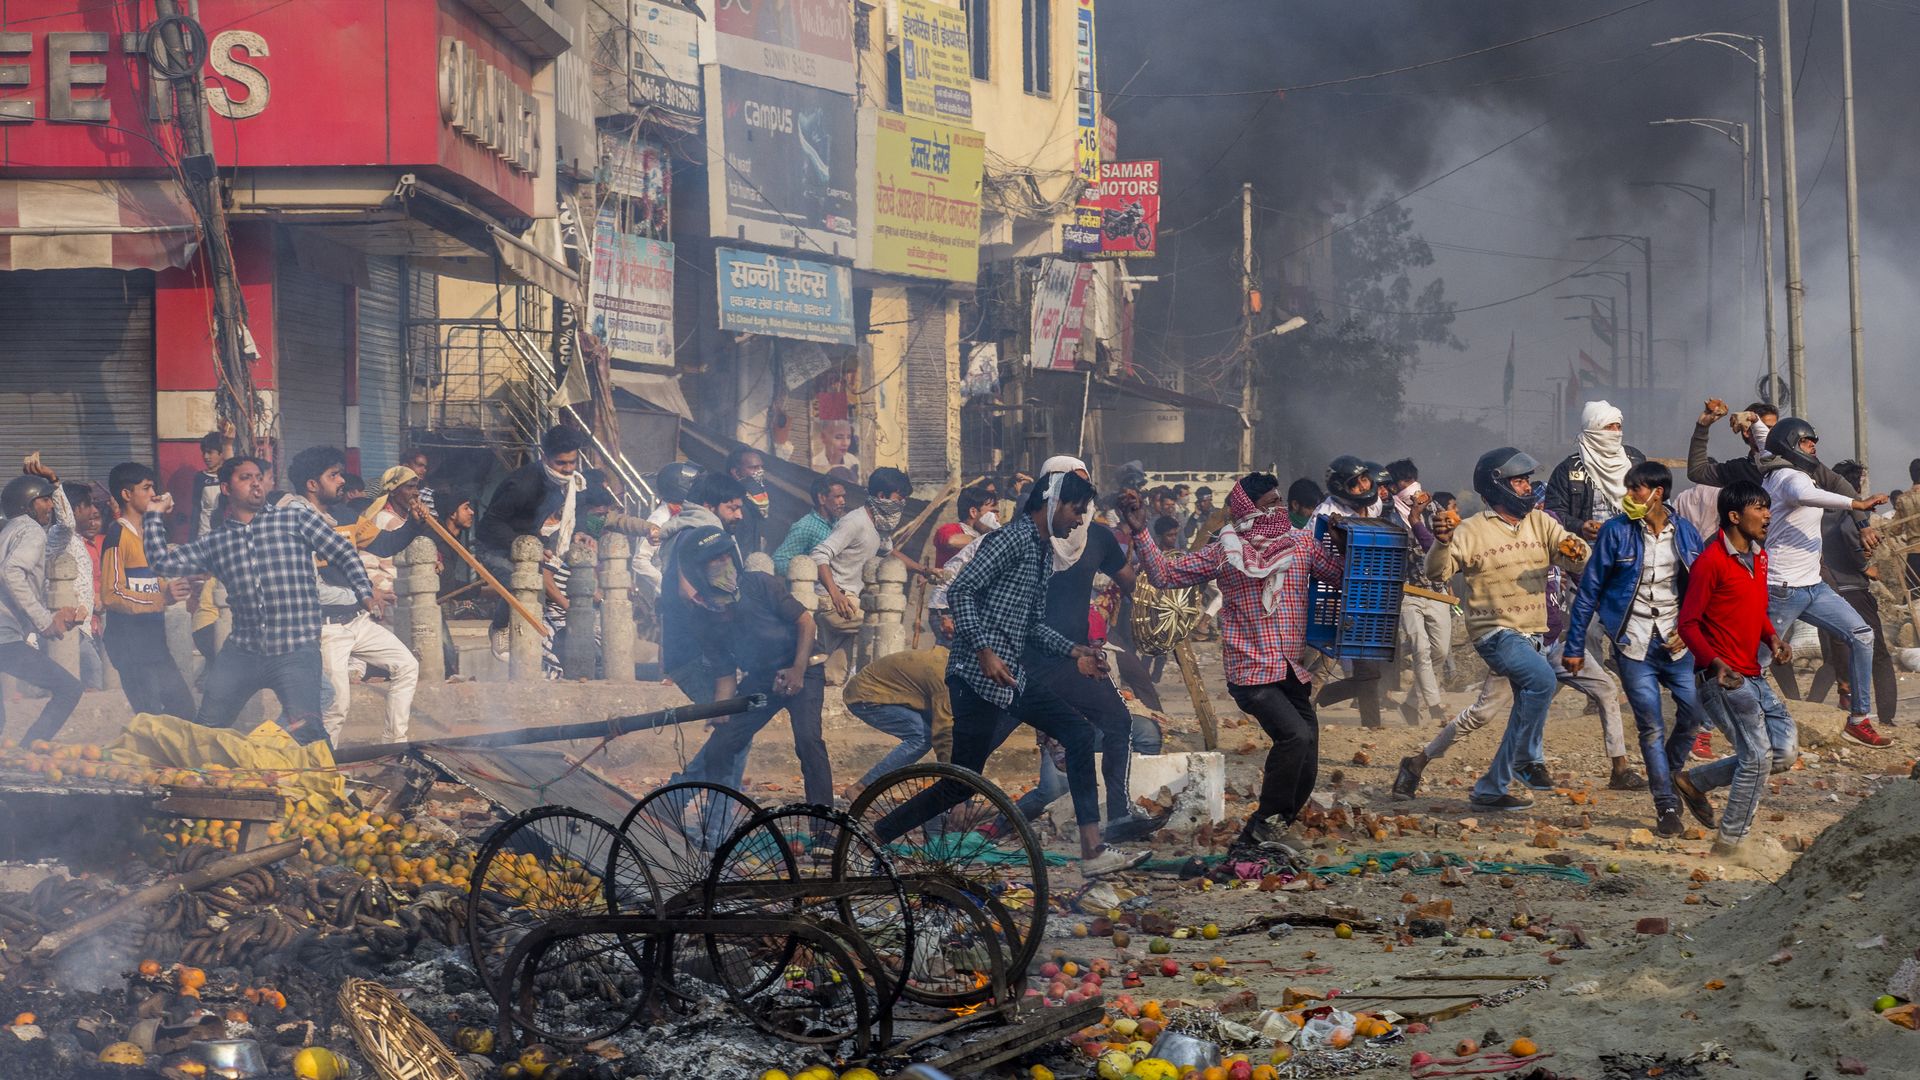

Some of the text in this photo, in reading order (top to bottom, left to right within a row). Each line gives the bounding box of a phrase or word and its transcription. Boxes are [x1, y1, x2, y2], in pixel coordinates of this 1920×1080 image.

[1102, 163, 1154, 178] SAMAR
[1099, 181, 1158, 196] MOTORS
[784, 259, 828, 299] सेल्स
